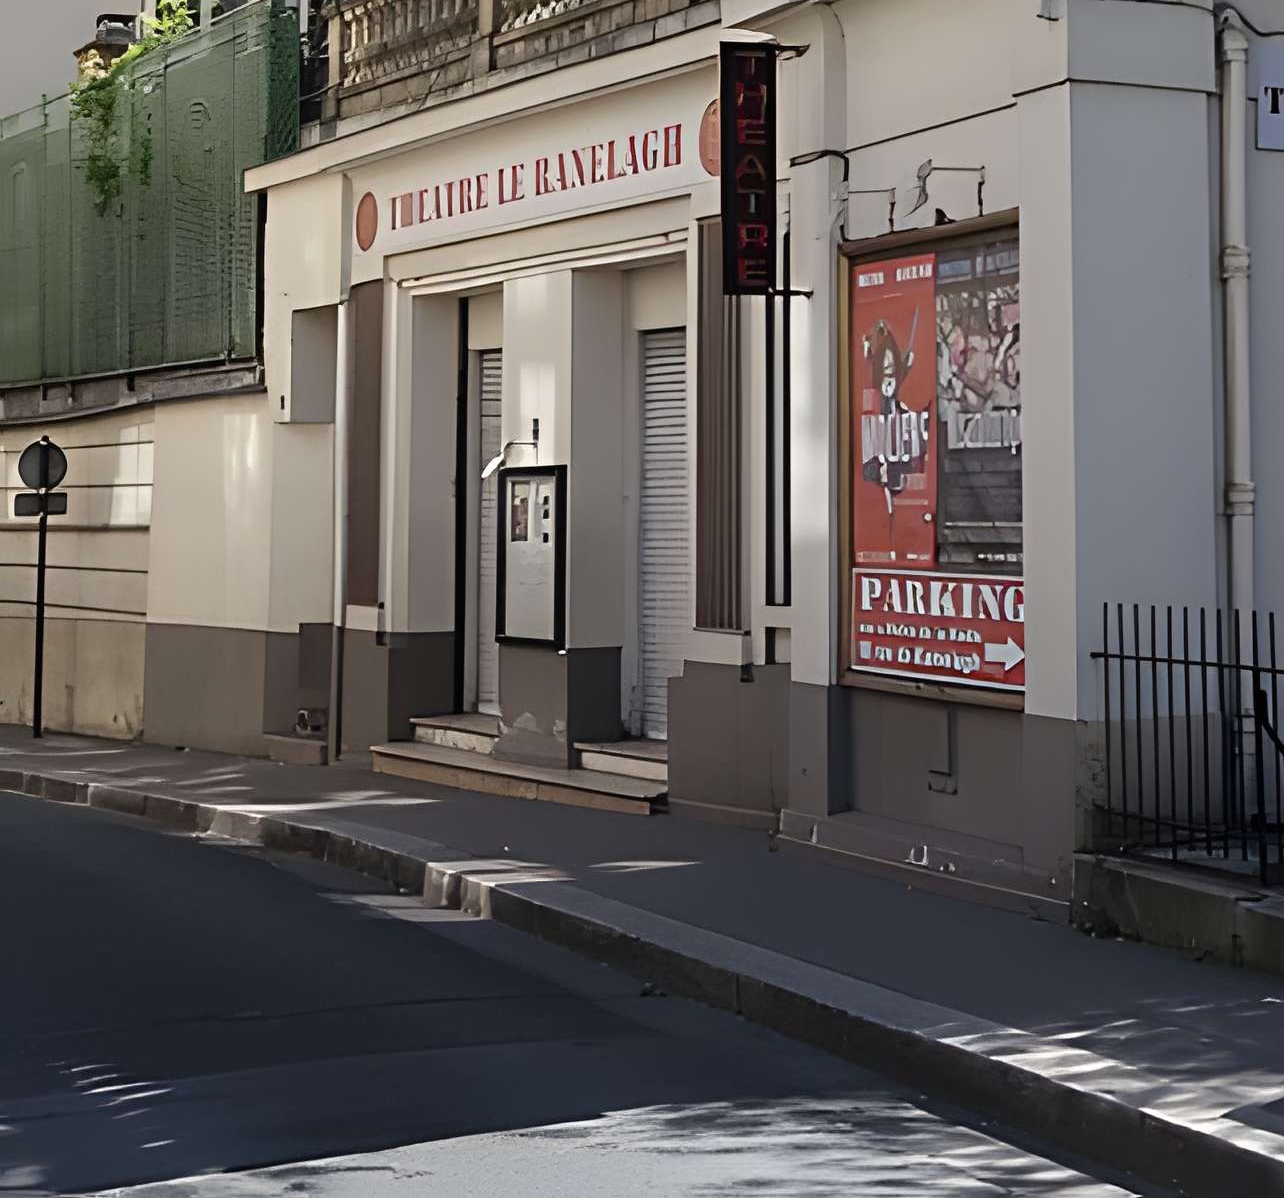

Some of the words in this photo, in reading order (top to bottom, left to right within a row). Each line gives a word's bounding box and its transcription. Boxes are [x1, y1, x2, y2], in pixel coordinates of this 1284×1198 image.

[498, 163, 525, 205] LE
[535, 123, 682, 196] RANELAGH
[861, 575, 1024, 623] PARKING
